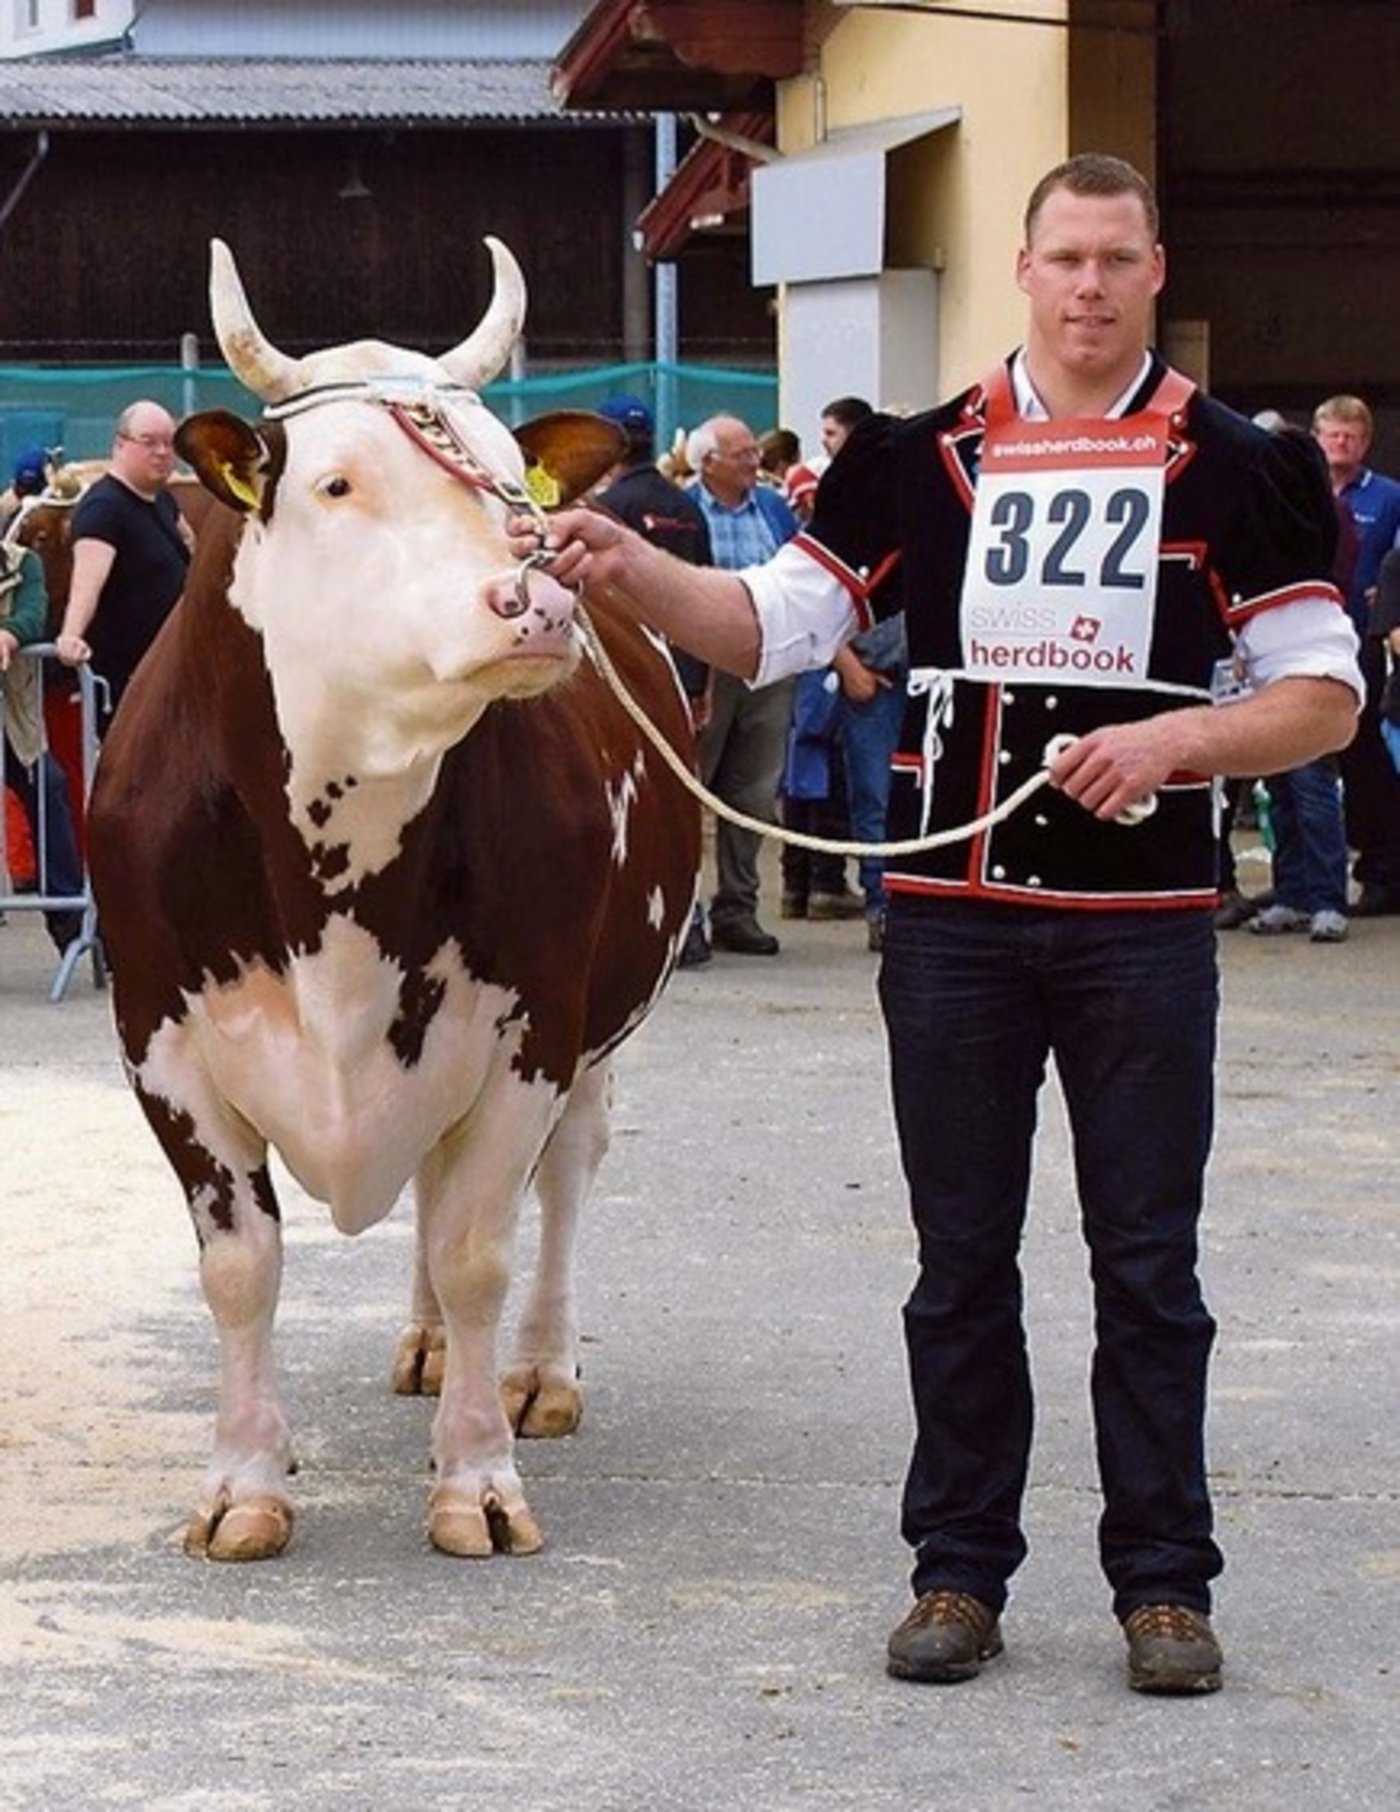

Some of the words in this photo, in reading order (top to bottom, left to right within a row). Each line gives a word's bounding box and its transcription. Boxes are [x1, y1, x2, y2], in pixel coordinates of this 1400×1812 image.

[993, 435, 1157, 458] swissherdbook.ch
[984, 488, 1150, 589] 322
[971, 601, 1057, 630] swiss
[971, 639, 1135, 673] herdbook
